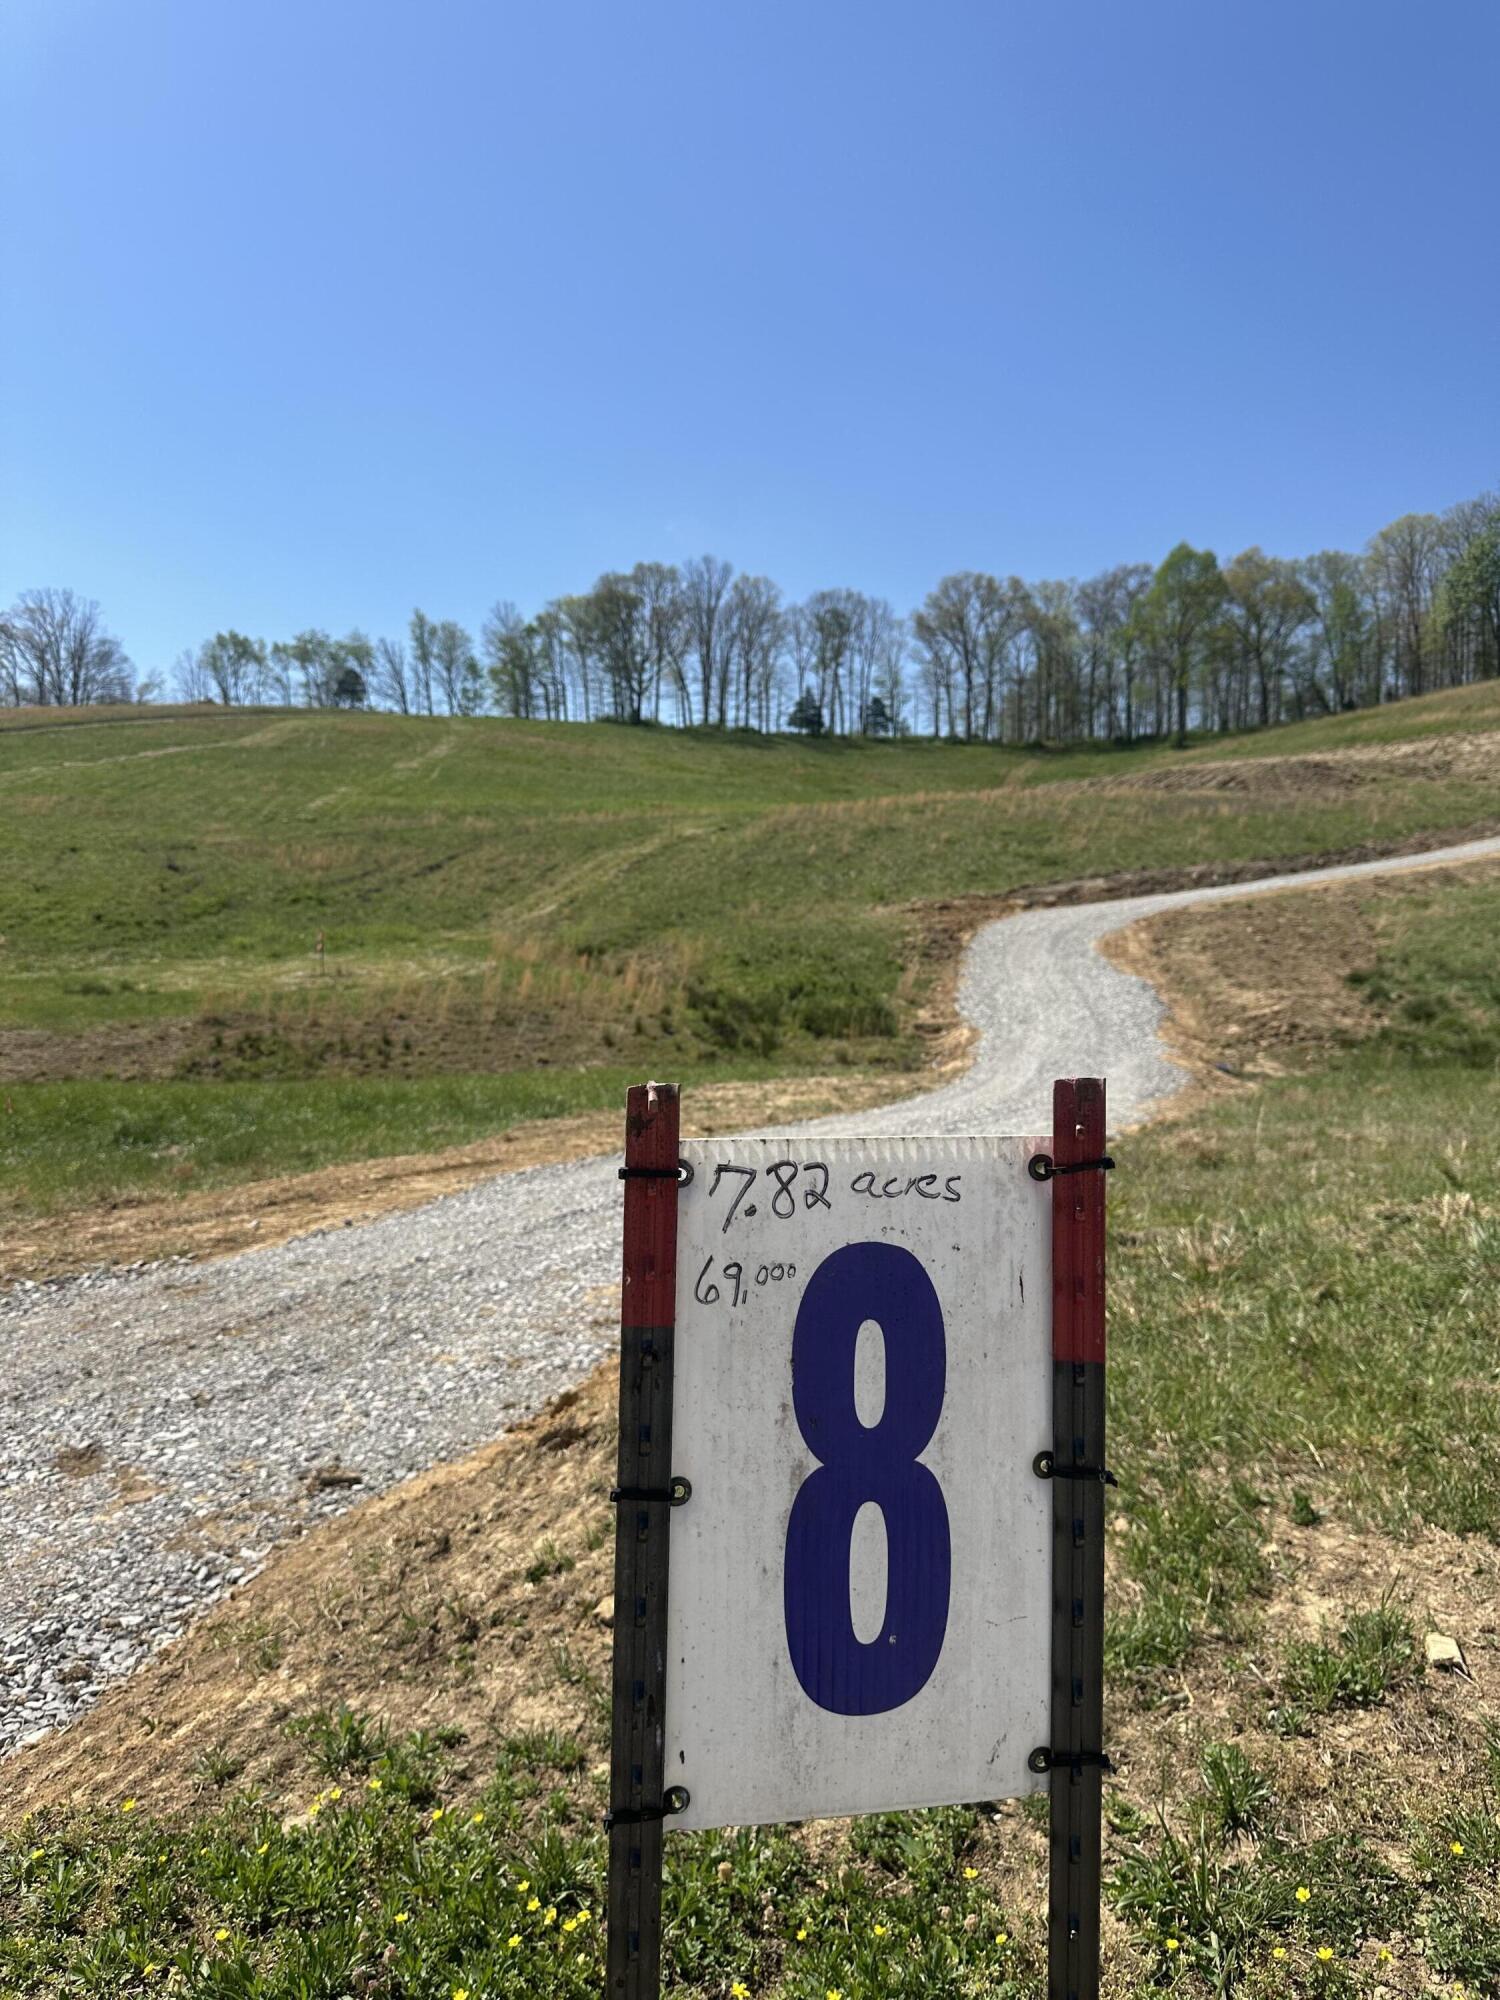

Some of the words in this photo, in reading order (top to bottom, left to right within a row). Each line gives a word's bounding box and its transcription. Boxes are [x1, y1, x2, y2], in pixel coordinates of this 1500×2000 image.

[708, 1160, 832, 1233] 7.82
[851, 1171, 961, 1202] acres
[695, 1254, 796, 1307] 69,000
[783, 1241, 951, 1716] 8
